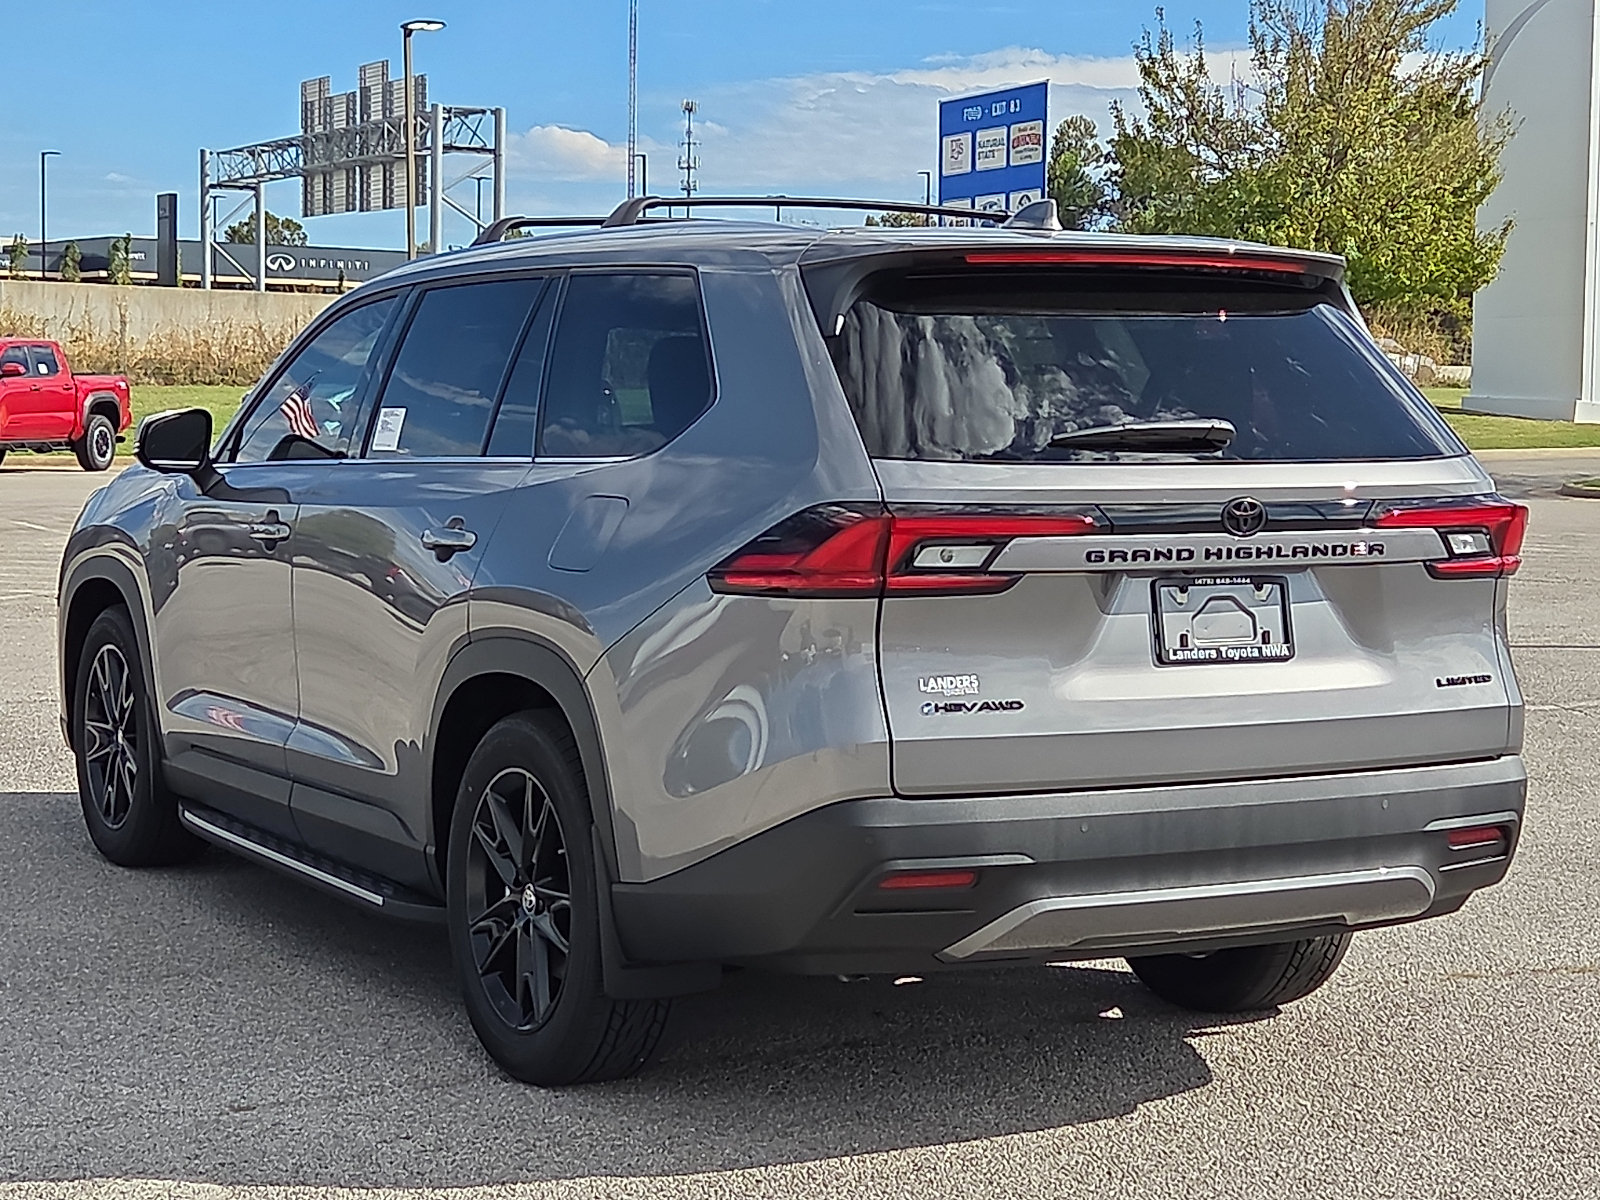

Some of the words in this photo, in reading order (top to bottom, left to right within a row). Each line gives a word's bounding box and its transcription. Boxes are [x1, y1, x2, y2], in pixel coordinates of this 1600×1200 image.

[300, 258, 370, 271] INFINITI
[1085, 548, 1195, 564] GRAND
[1204, 542, 1386, 561] HIGHLANDER
[1168, 646, 1218, 661] Landers
[1219, 644, 1260, 660] Toyota
[1261, 643, 1291, 657] NWA
[919, 674, 979, 693] LANDERS
